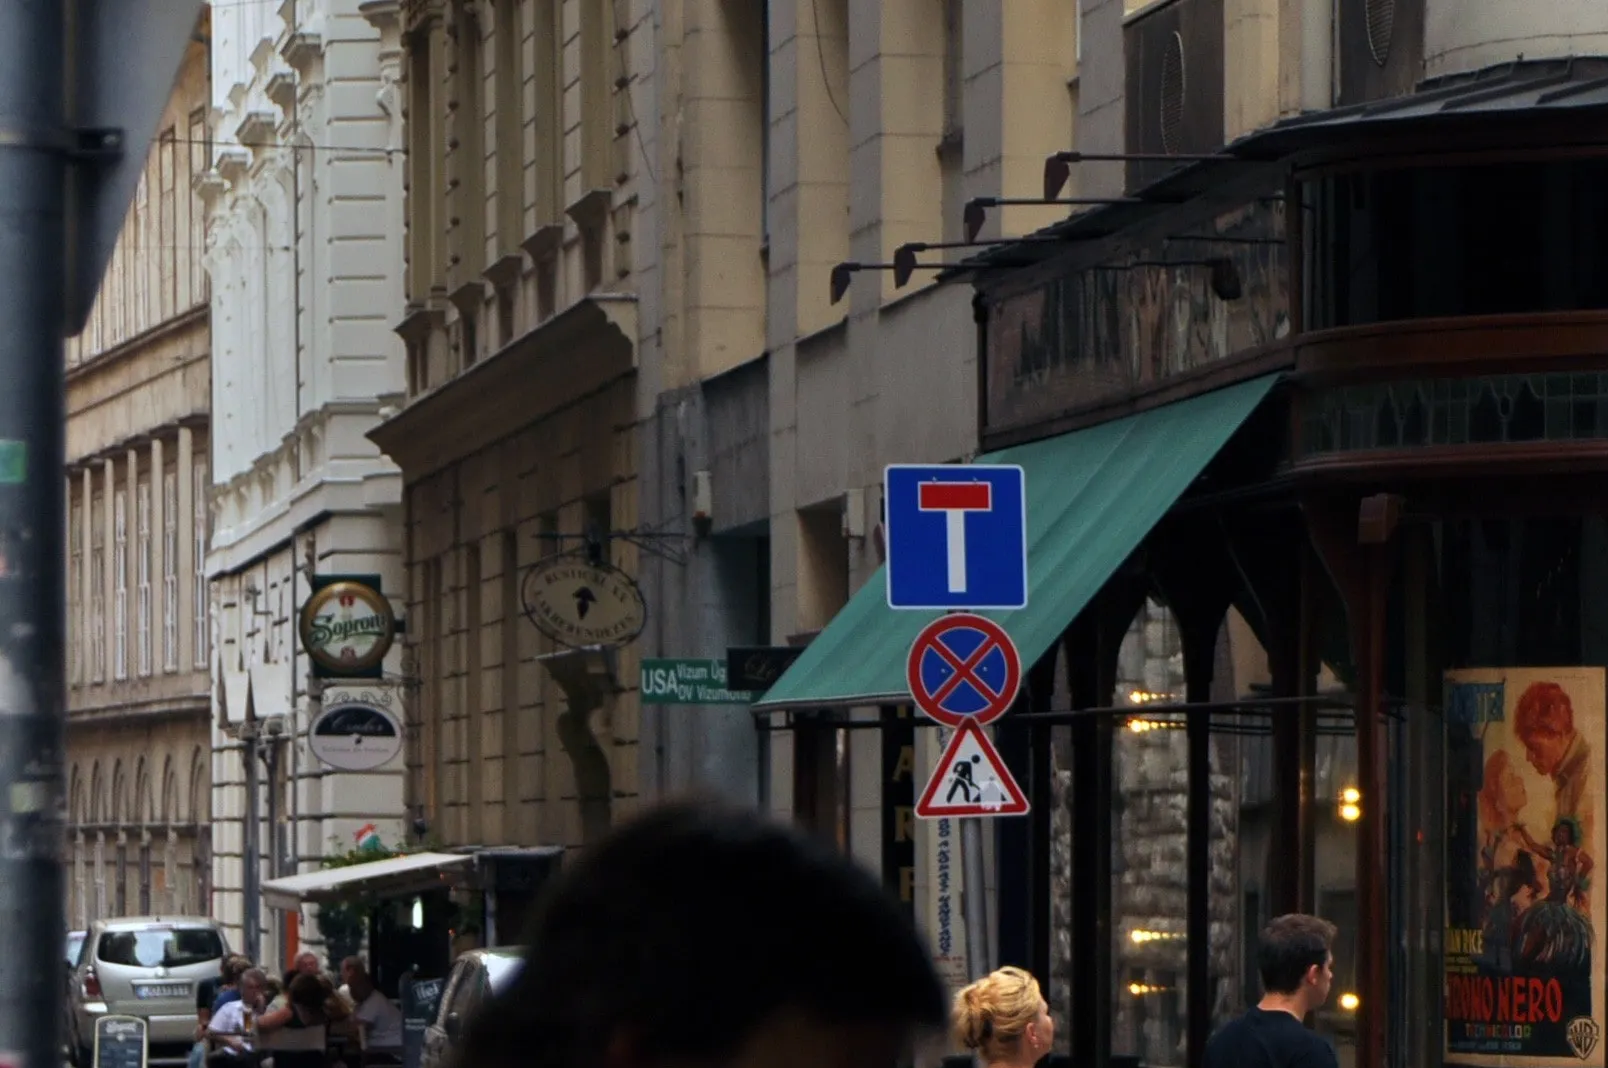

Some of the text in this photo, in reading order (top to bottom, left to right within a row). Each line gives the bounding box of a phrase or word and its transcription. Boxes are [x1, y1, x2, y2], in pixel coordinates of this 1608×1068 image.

[641, 669, 678, 695] USA
[676, 664, 707, 680] Vizum
[1497, 976, 1564, 1024] NERO
